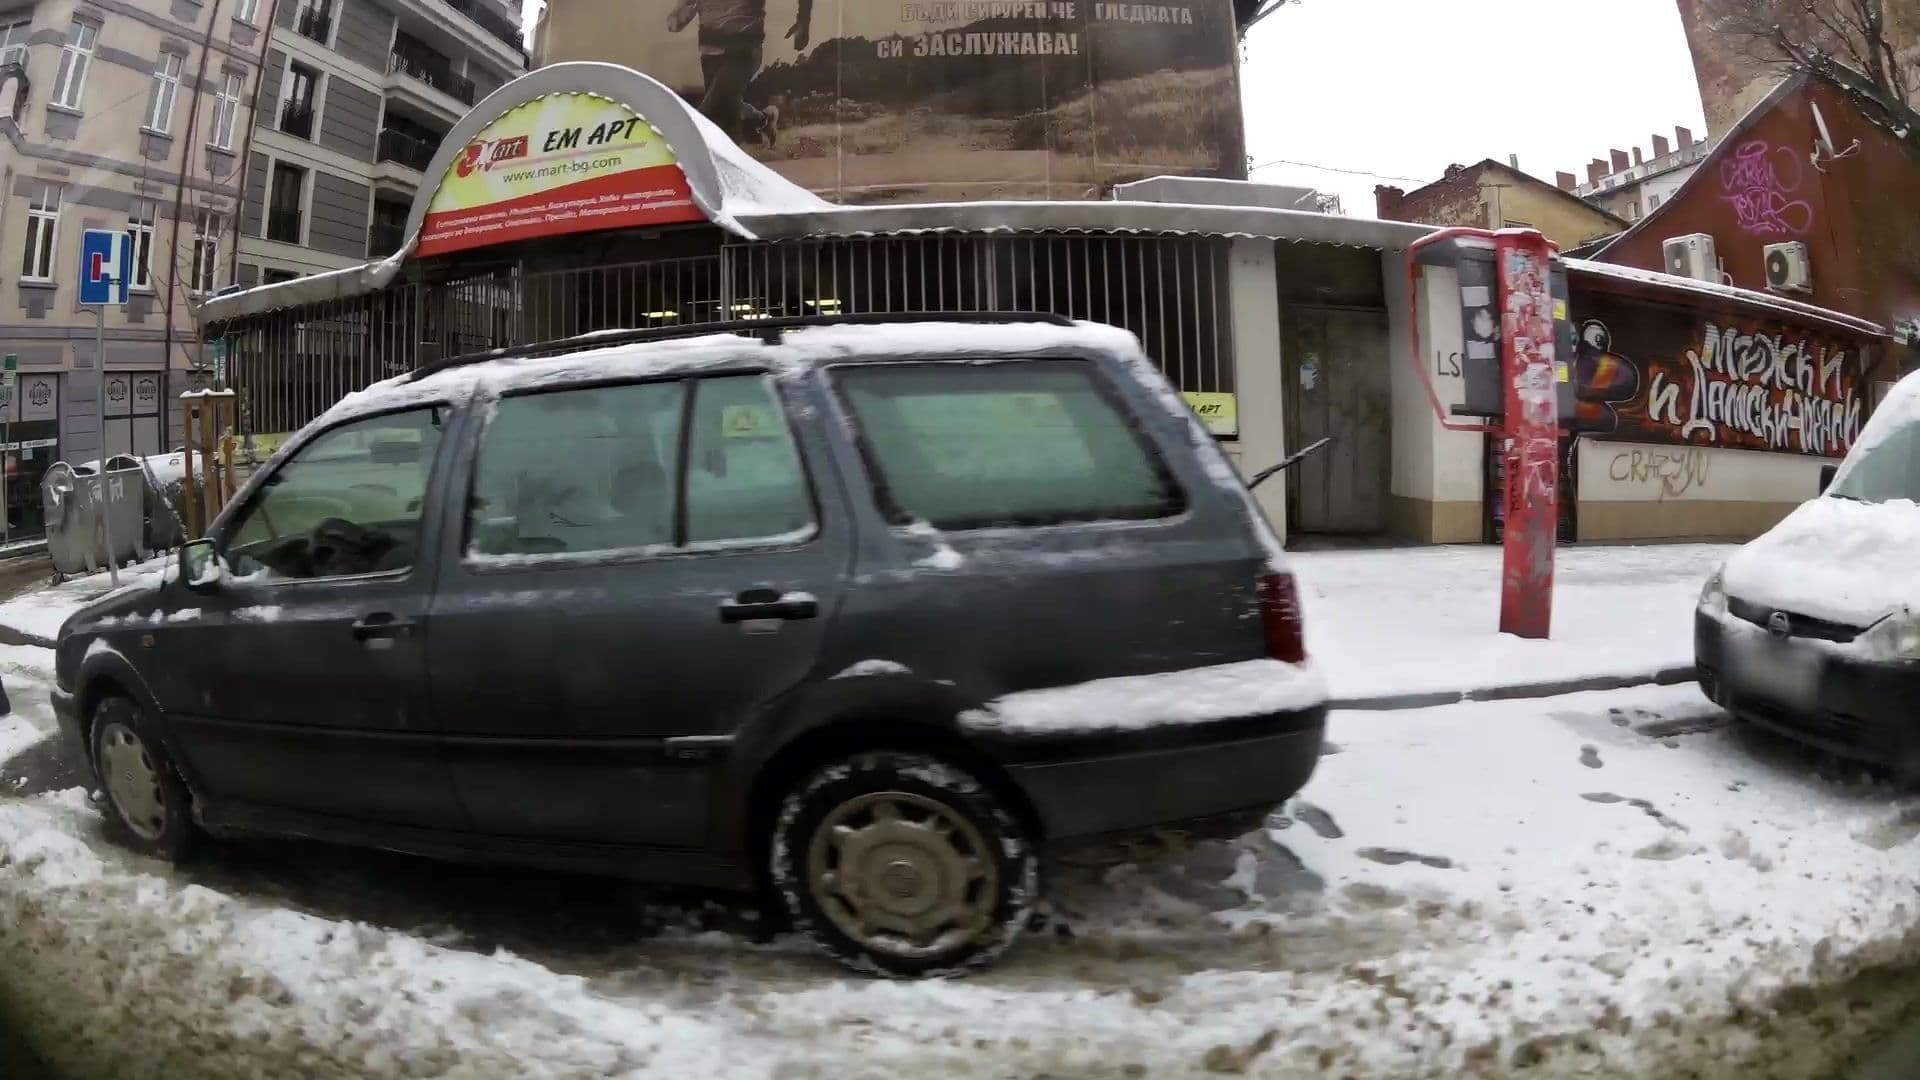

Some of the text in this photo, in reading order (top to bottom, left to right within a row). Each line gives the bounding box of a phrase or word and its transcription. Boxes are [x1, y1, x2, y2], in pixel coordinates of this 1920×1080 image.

[1095, 3, 1193, 25] ГЛЕДКАТА
[914, 31, 1078, 57] ЗАСЛУЖАВА!
[502, 155, 622, 184] www.mart-bg.com
